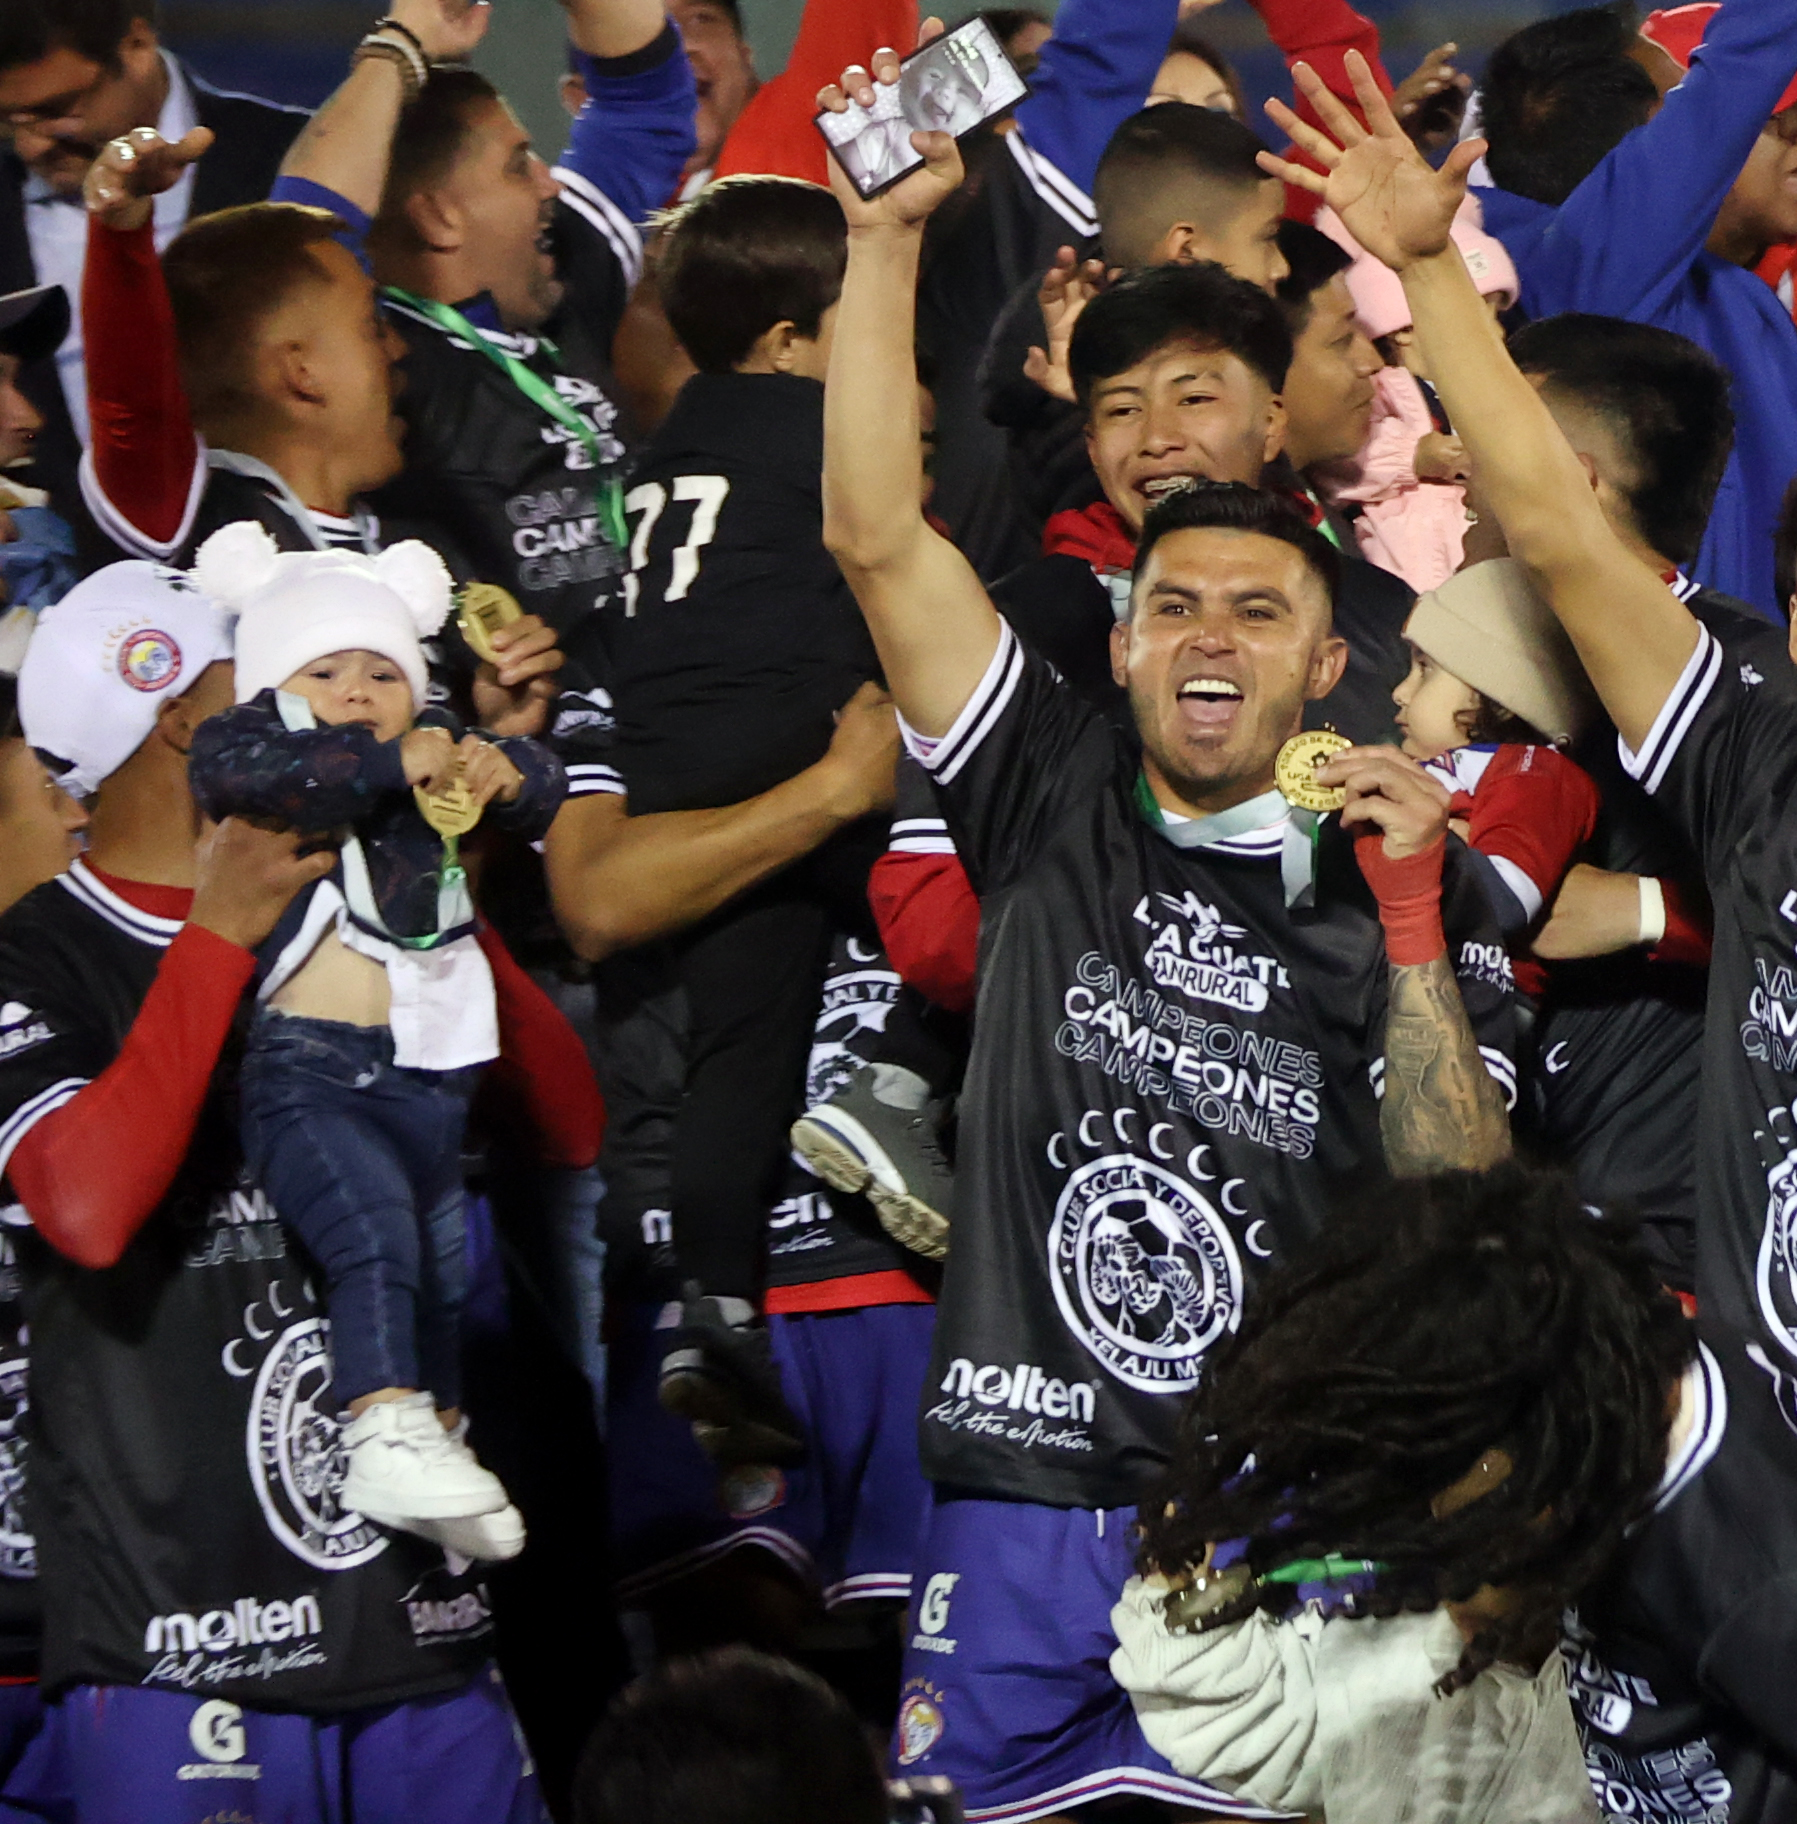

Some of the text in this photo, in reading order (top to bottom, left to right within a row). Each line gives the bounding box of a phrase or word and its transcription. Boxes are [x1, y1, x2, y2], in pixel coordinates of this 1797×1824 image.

[1064, 985, 1321, 1124] CAMPEONES
[1054, 1020, 1316, 1160] CAMPEONES
[1058, 1197, 1086, 1260] CLUB
[144, 1594, 323, 1654] molten
[918, 1571, 961, 1635] G
[188, 1698, 247, 1763] G
